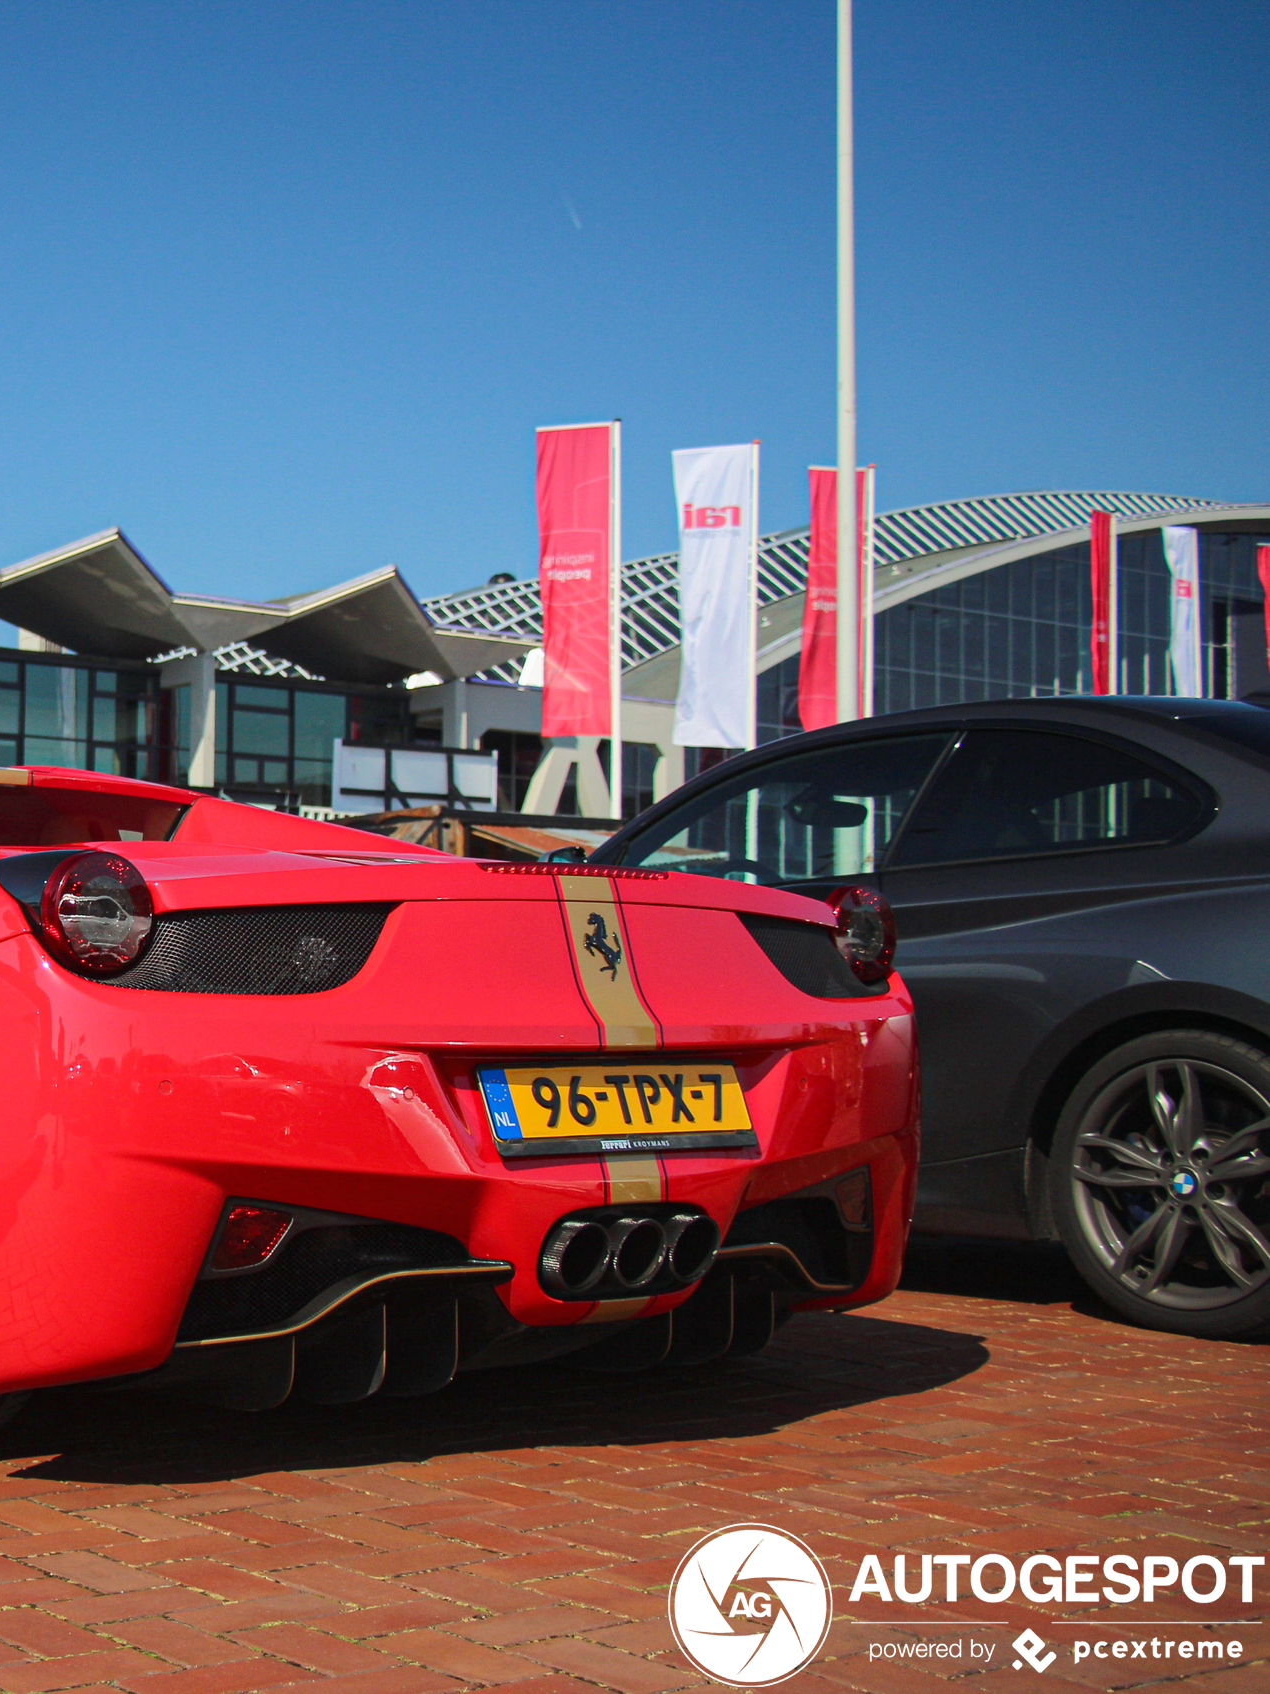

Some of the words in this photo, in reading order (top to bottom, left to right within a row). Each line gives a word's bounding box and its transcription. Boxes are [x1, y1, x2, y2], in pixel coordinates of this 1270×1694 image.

[531, 1073, 723, 1128] 96-TPX-7
[493, 1111, 516, 1127] NL
[600, 1140, 632, 1150] Ferrari
[632, 1140, 670, 1148] KROYMANS
